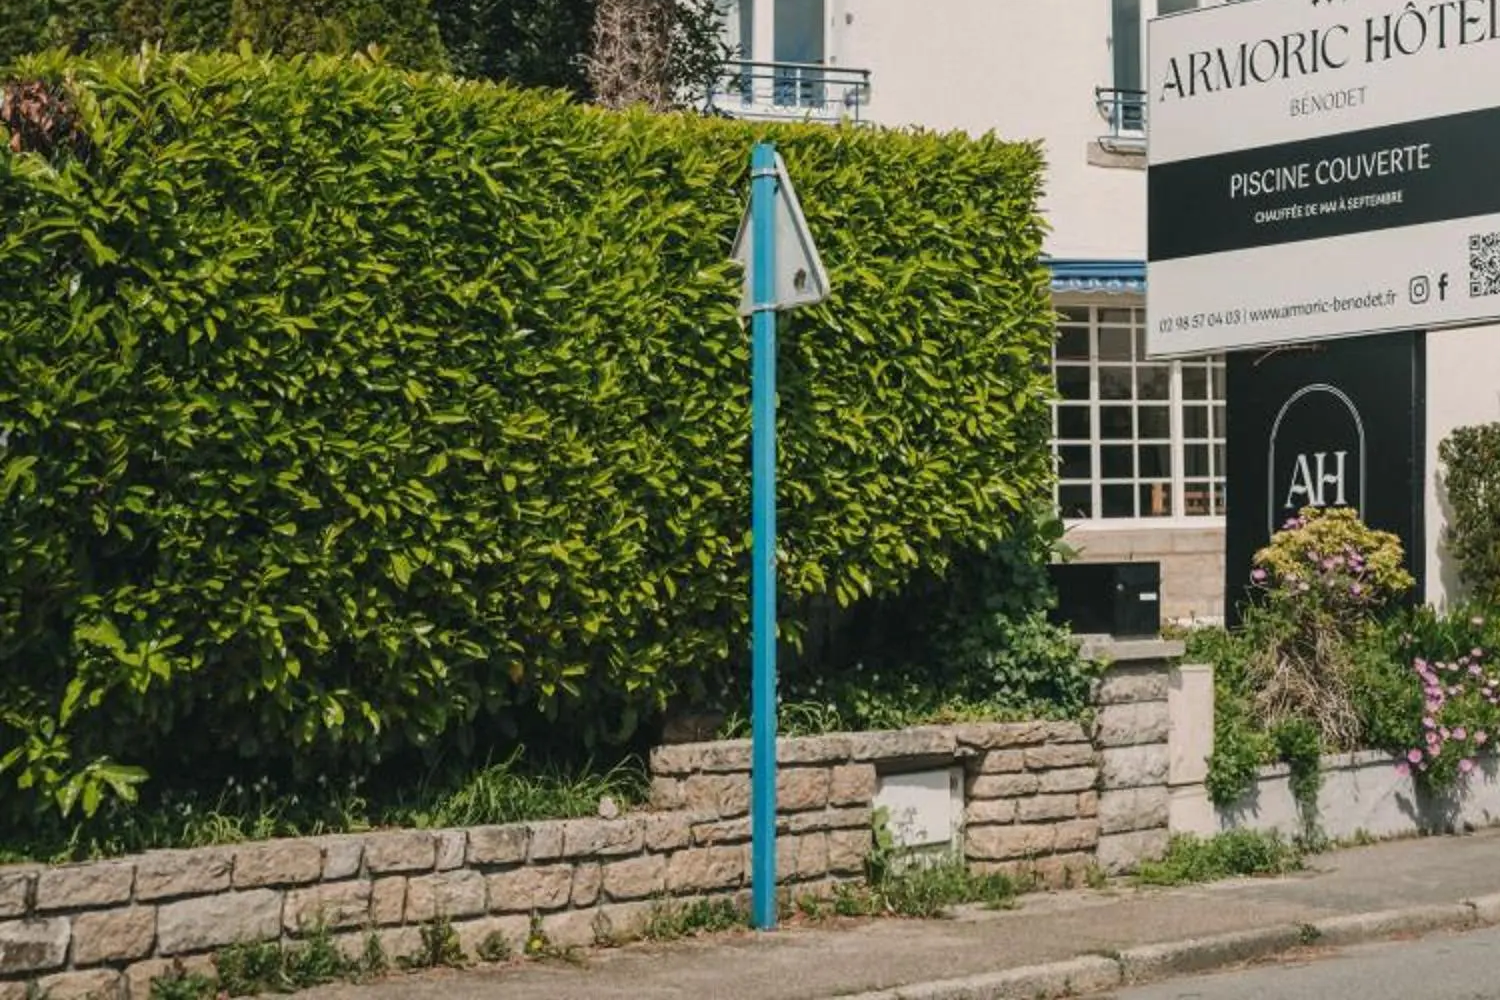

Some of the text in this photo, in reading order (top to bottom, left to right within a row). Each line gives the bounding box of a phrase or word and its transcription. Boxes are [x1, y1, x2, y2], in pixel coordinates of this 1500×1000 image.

[1159, 24, 1348, 102] ARMORIC
[1230, 143, 1431, 199] PISCINE COUVERTE
[1254, 203, 1303, 224] CHAUFFÉE
[1305, 203, 1318, 217] DE
[1320, 201, 1337, 215] MAI
[1347, 189, 1403, 209] SEPTEMBRE
[1159, 318, 1173, 333] 02
[1191, 313, 1206, 329] 57
[1207, 311, 1223, 328] 04
[1249, 289, 1398, 323] www.armoric-benodet.fr
[1284, 450, 1348, 508] AH
